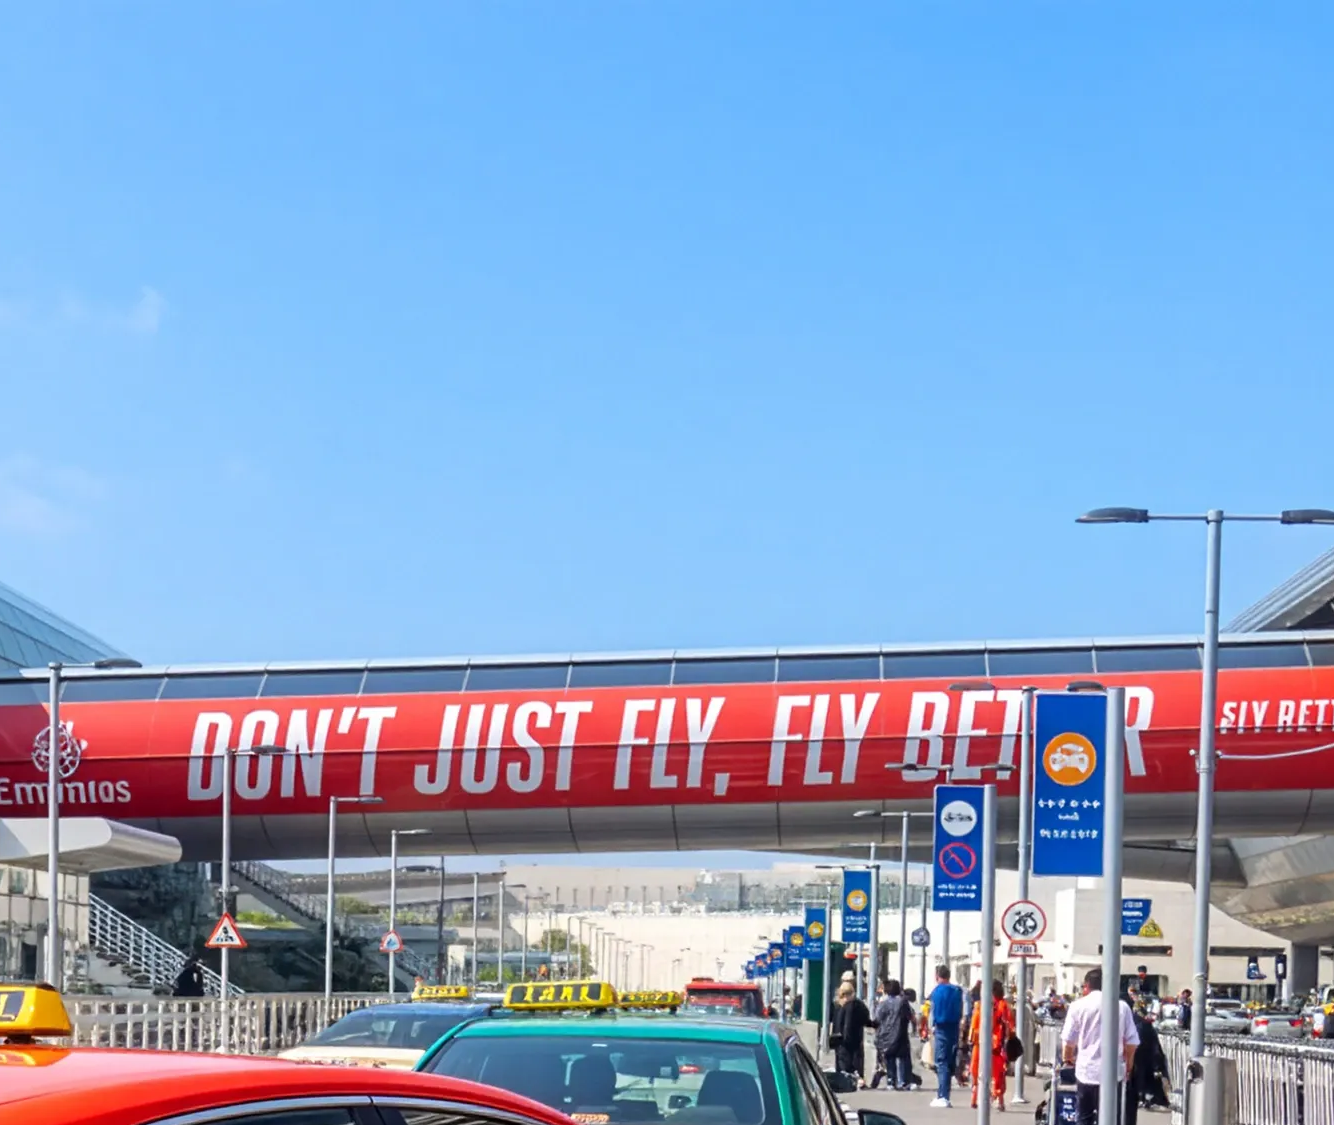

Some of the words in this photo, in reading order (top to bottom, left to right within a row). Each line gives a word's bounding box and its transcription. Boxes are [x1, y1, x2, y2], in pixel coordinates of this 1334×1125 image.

[187, 706, 397, 800] DON'T
[414, 701, 593, 795] JUST
[613, 697, 731, 796] FLY,
[767, 692, 880, 786] FLY
[901, 686, 1154, 782] BETR
